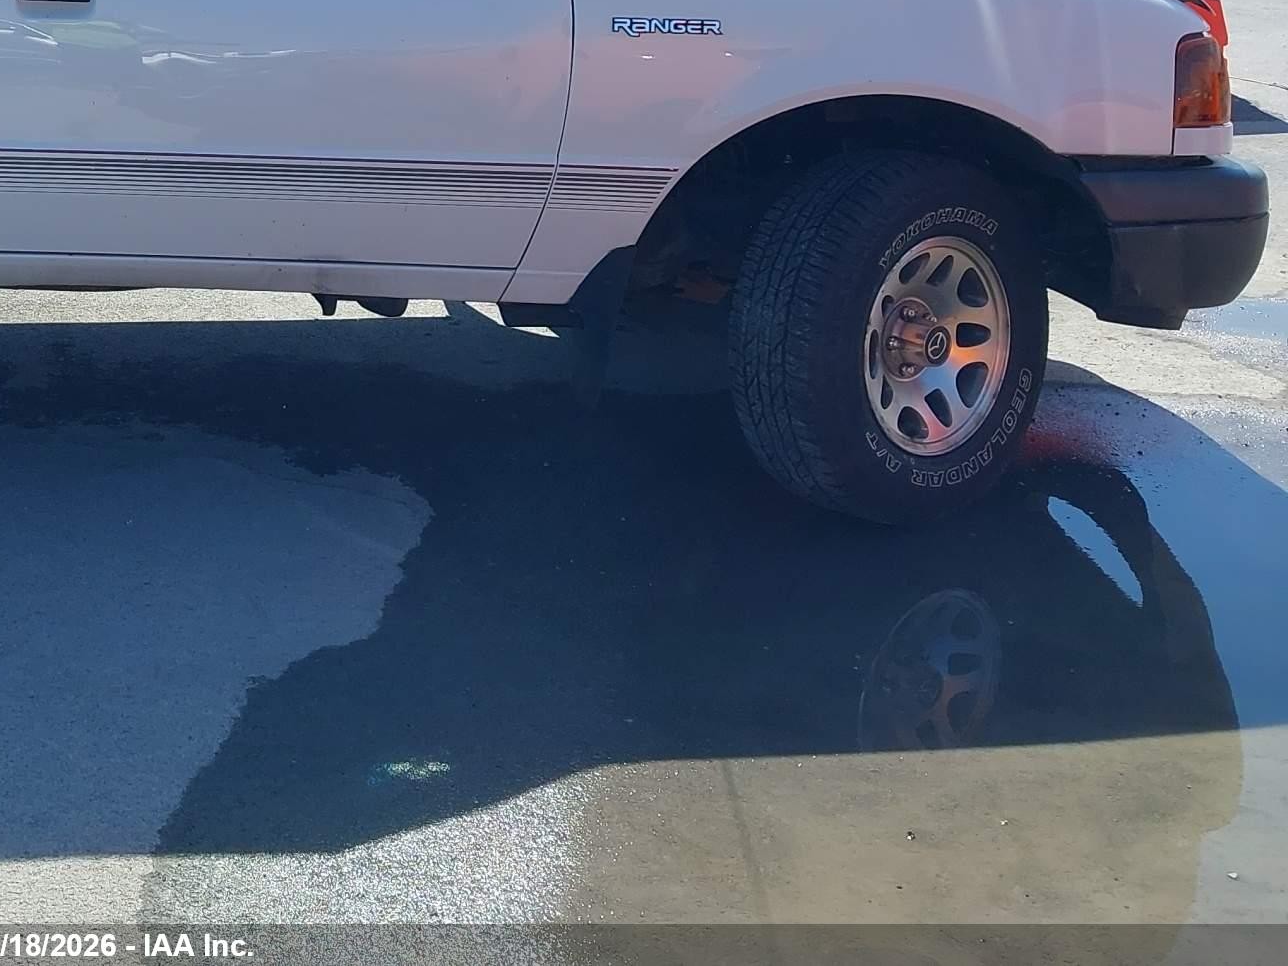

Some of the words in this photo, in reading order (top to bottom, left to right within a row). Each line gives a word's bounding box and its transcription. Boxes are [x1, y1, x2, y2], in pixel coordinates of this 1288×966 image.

[612, 17, 724, 37] RANGER
[879, 207, 999, 268] YOKOHAMA
[865, 432, 902, 473] A/T
[912, 368, 1033, 488] GEOLANDAR
